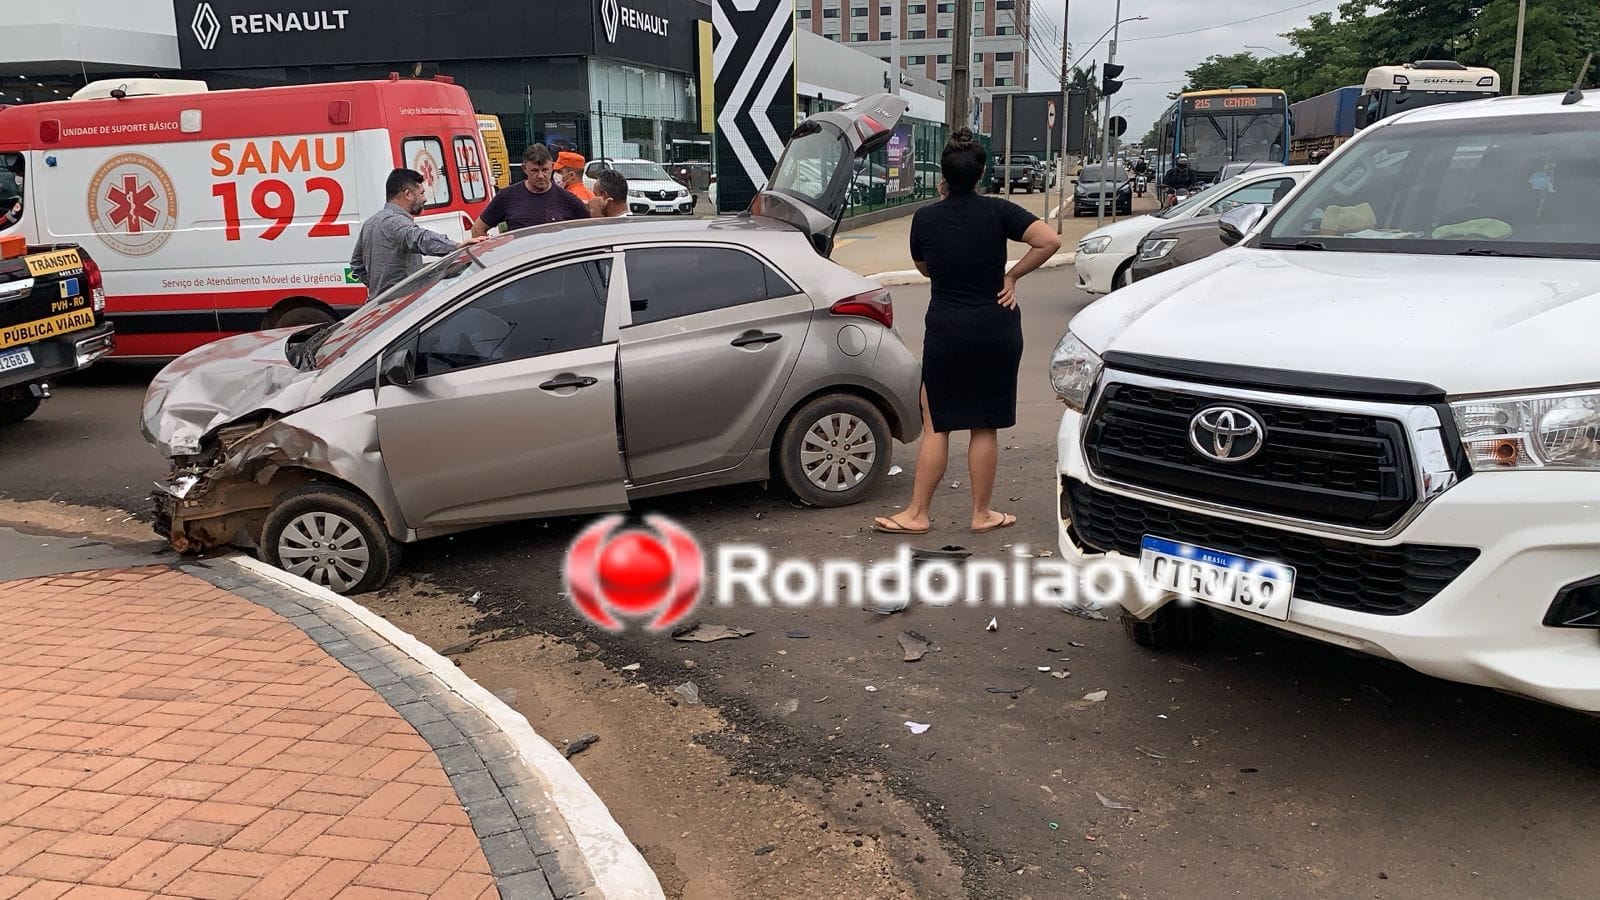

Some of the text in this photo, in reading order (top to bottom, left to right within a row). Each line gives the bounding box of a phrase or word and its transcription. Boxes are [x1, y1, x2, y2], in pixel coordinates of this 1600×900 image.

[230, 9, 349, 34] RENAULT
[620, 6, 669, 37] RENAULT
[1194, 96, 1257, 109] 215 CENTRO
[62, 120, 178, 137] UNIDADE DE SUPORTE BÁSICO
[210, 136, 346, 177] SAMU
[457, 145, 477, 168] 192
[211, 176, 351, 242] 192
[29, 253, 79, 272] TRÂNSITO
[162, 273, 342, 289] Serviço de Atendimento Móvel de Urgência
[51, 300, 69, 313] PVH
[73, 296, 85, 307] RO
[4, 312, 92, 344] PÚBLICA VIÁRIA
[1202, 553, 1228, 566] BRASIL
